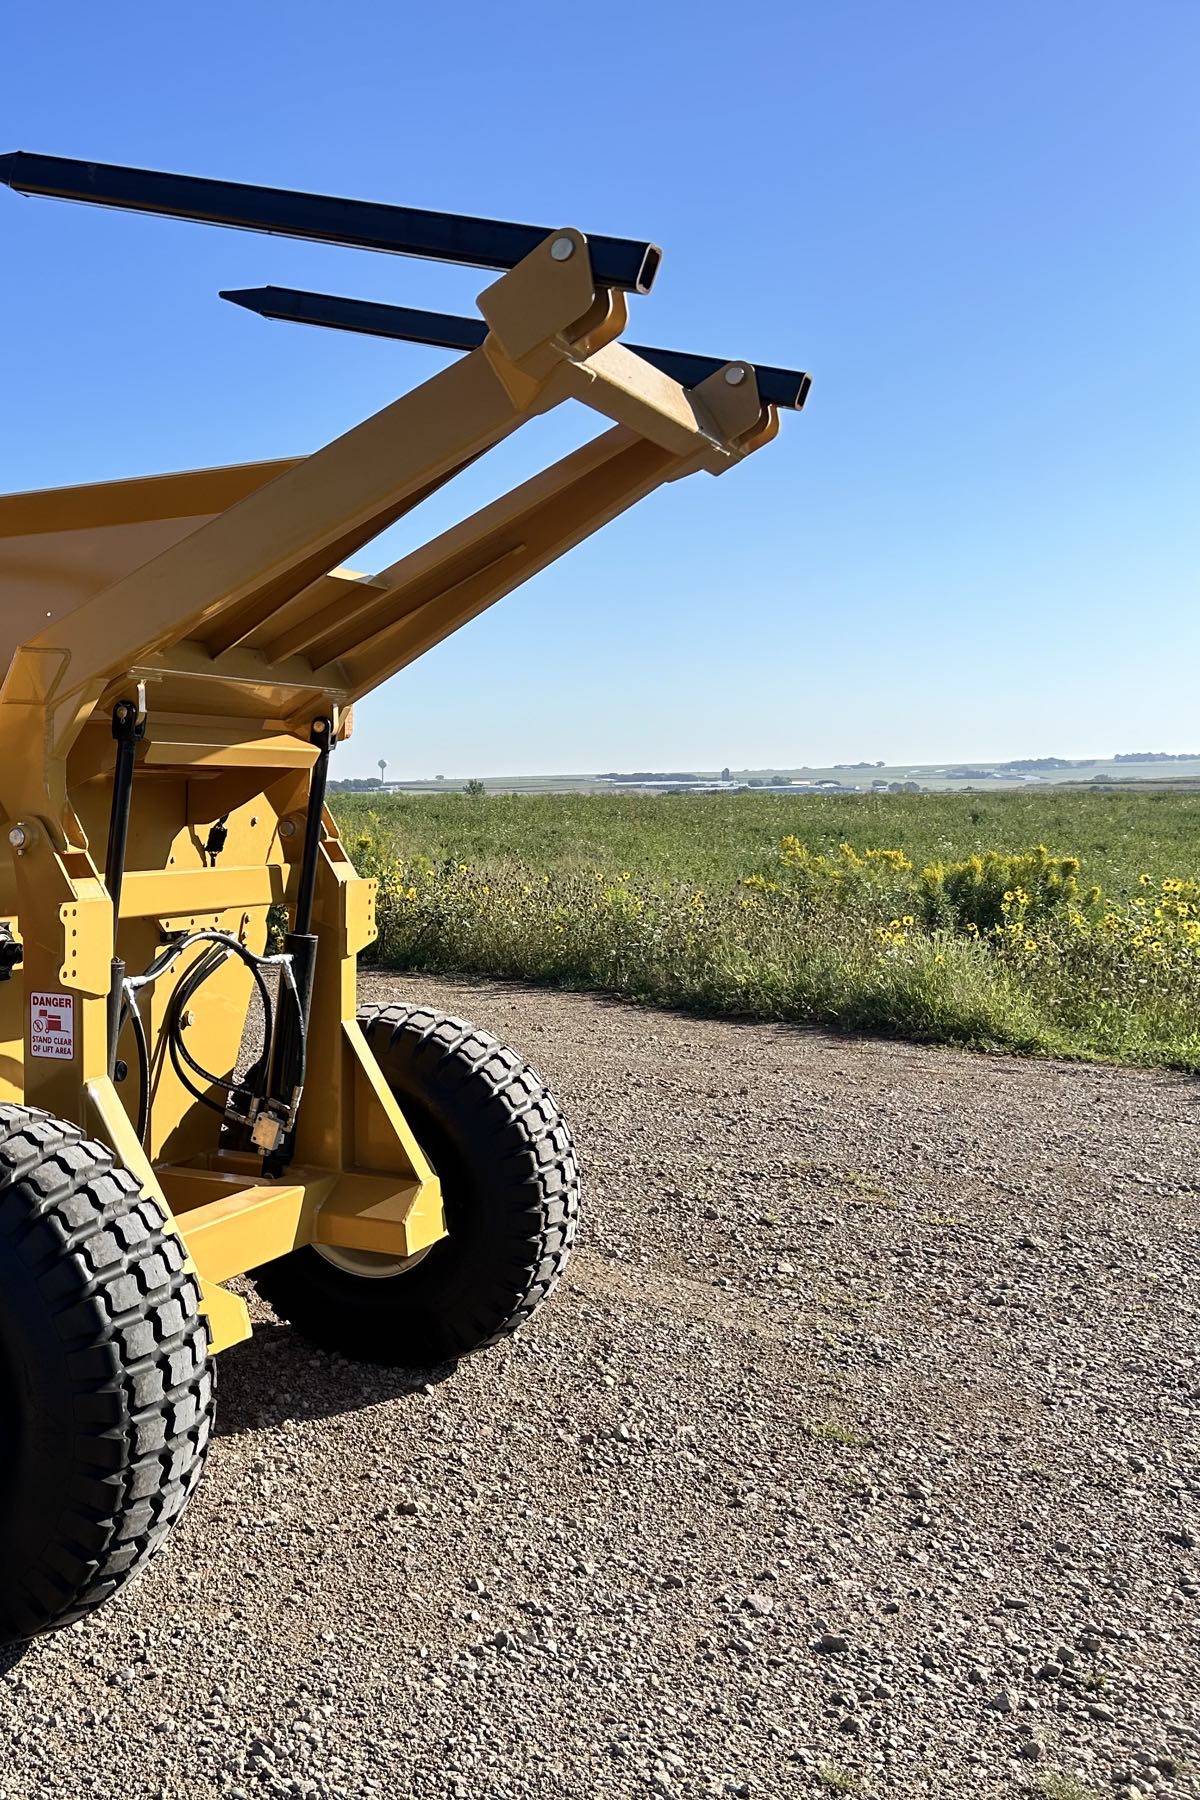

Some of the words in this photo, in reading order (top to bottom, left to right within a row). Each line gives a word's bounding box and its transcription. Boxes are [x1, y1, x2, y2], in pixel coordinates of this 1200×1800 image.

[32, 996, 72, 1008] DANGER
[32, 1035, 52, 1044] STAND
[53, 1037, 72, 1046] CLEAR
[32, 1044, 41, 1052] OF
[42, 1045, 54, 1054] LIFT
[55, 1047, 72, 1056] AREA
